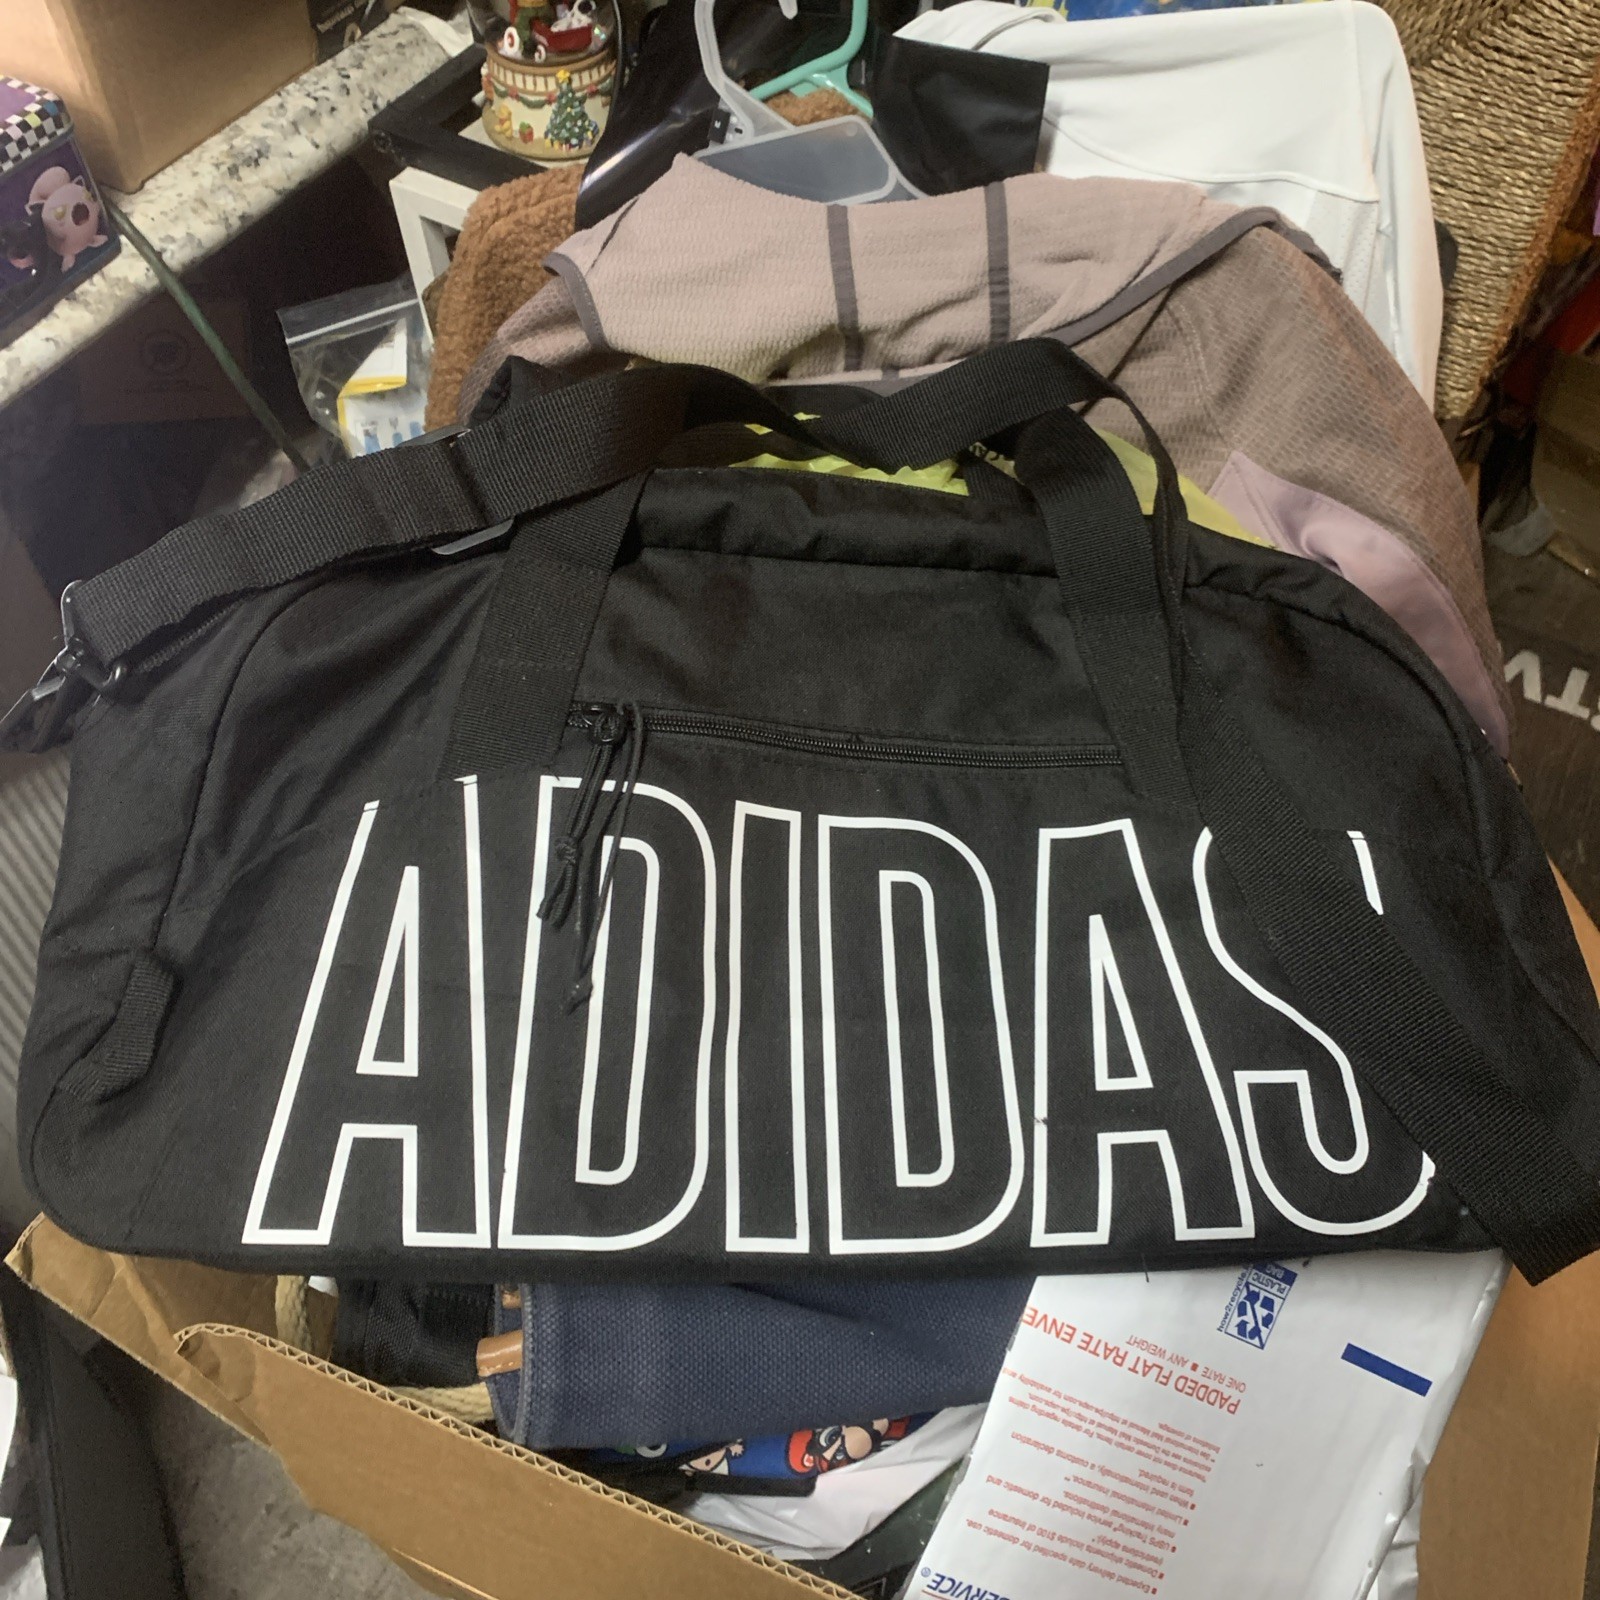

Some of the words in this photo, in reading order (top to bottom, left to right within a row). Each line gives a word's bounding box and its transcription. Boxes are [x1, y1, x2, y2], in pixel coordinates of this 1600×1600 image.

[242, 775, 1436, 1254] ADIDAS
[1265, 1264, 1285, 1279] BAG
[1251, 1272, 1288, 1294] PLASTIC
[1075, 1331, 1129, 1367] RATE
[1124, 1333, 1168, 1359] WEIGHT
[1166, 1350, 1189, 1368] ANY
[1126, 1354, 1173, 1386] FLAT
[1200, 1366, 1226, 1384] RATE
[1171, 1372, 1242, 1415] PADDED
[1225, 1376, 1247, 1393] ONE
[1009, 1431, 1055, 1455] declaration
[1054, 1449, 1089, 1468] customs
[1089, 1462, 1096, 1470] a
[985, 1474, 1002, 1487] and
[1002, 1480, 1039, 1501] domestic
[1039, 1495, 1052, 1506] for
[1051, 1499, 1085, 1519] included
[987, 1507, 1027, 1529] insurance
[1026, 1522, 1036, 1533] of
[1086, 1512, 1113, 1528] service
[982, 1524, 1020, 1546] domestic
[1035, 1526, 1056, 1541] $100
[1056, 1533, 1085, 1550] include
[1019, 1539, 1032, 1550] for
[1067, 1556, 1086, 1569] date
[1086, 1562, 1117, 1581] delivery
[1123, 1557, 1158, 1577] Domestic
